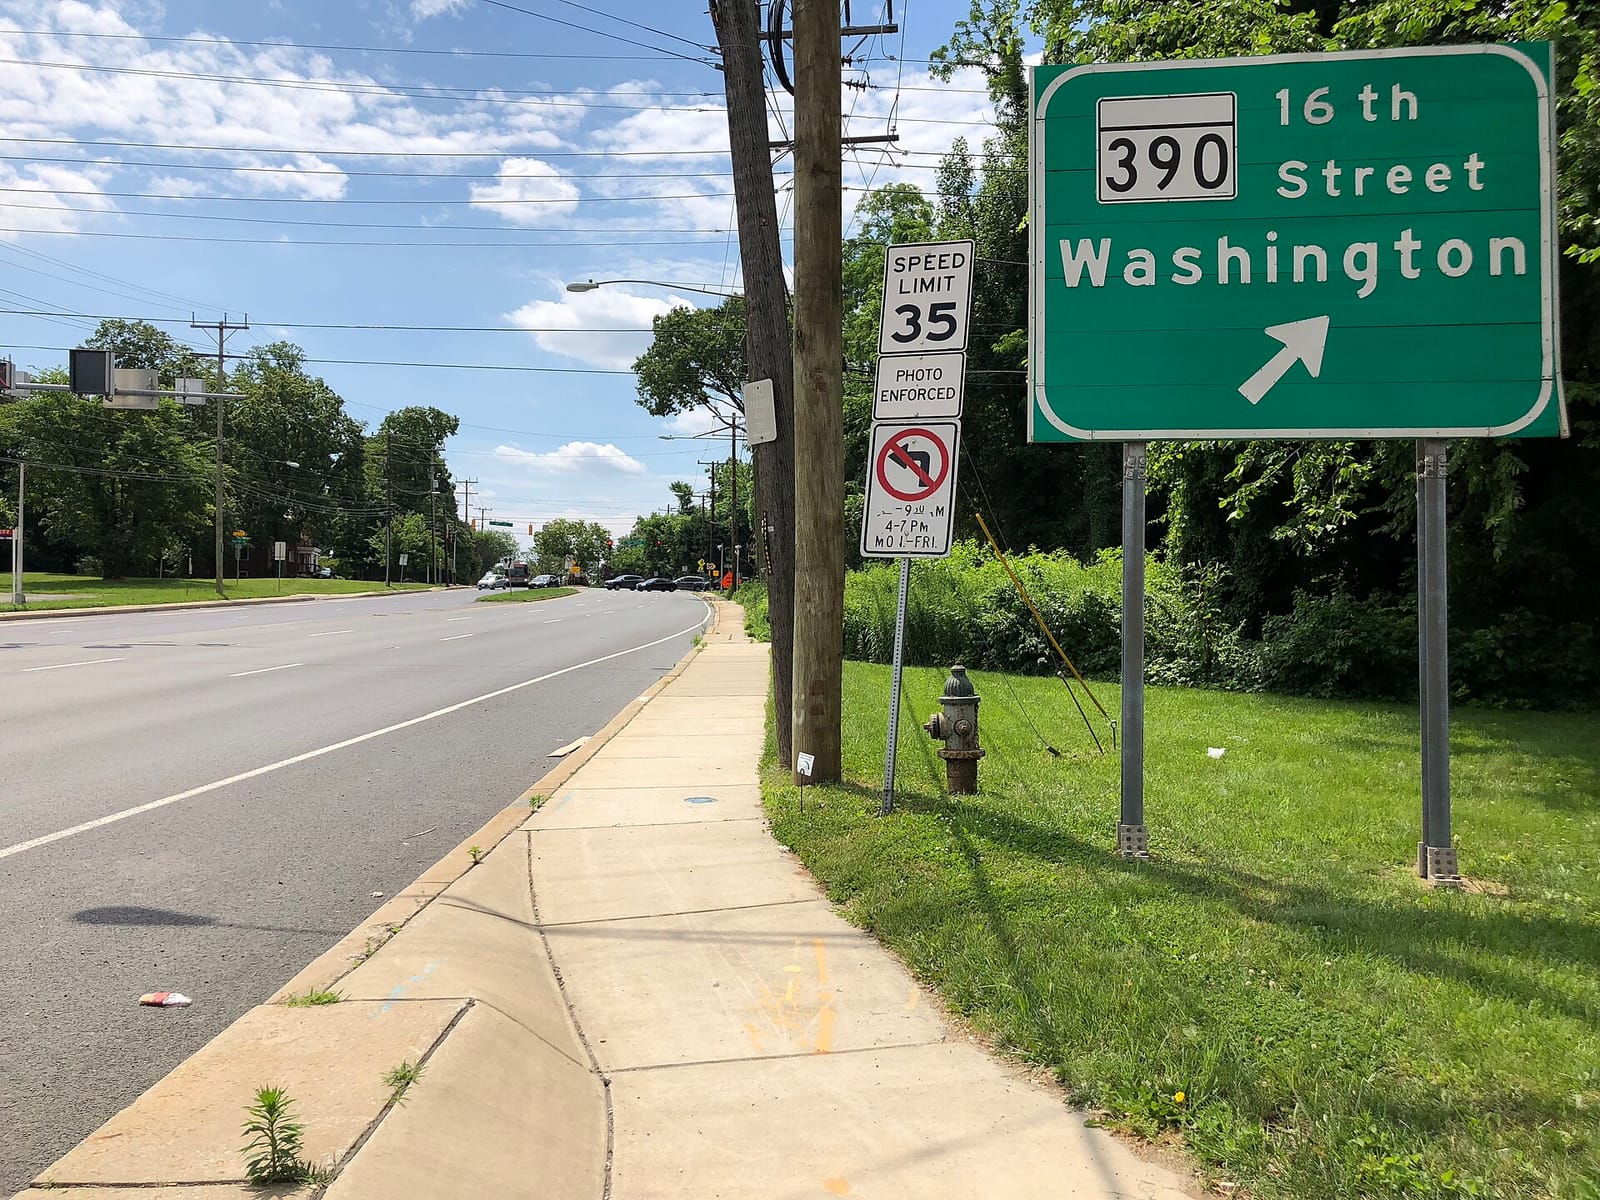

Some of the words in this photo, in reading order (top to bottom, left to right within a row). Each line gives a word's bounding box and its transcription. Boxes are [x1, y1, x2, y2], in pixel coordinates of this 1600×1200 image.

[1105, 133, 1229, 192] 390
[1277, 153, 1485, 198] Street
[893, 252, 965, 273] SPEED
[1059, 229, 1526, 298] Washington
[899, 275, 955, 294] LIMIT
[891, 302, 957, 343] 35
[896, 368, 942, 382] PHOTO
[881, 387, 956, 402] ENFORCED
[885, 520, 907, 532] 4-7
[911, 520, 928, 533] PM
